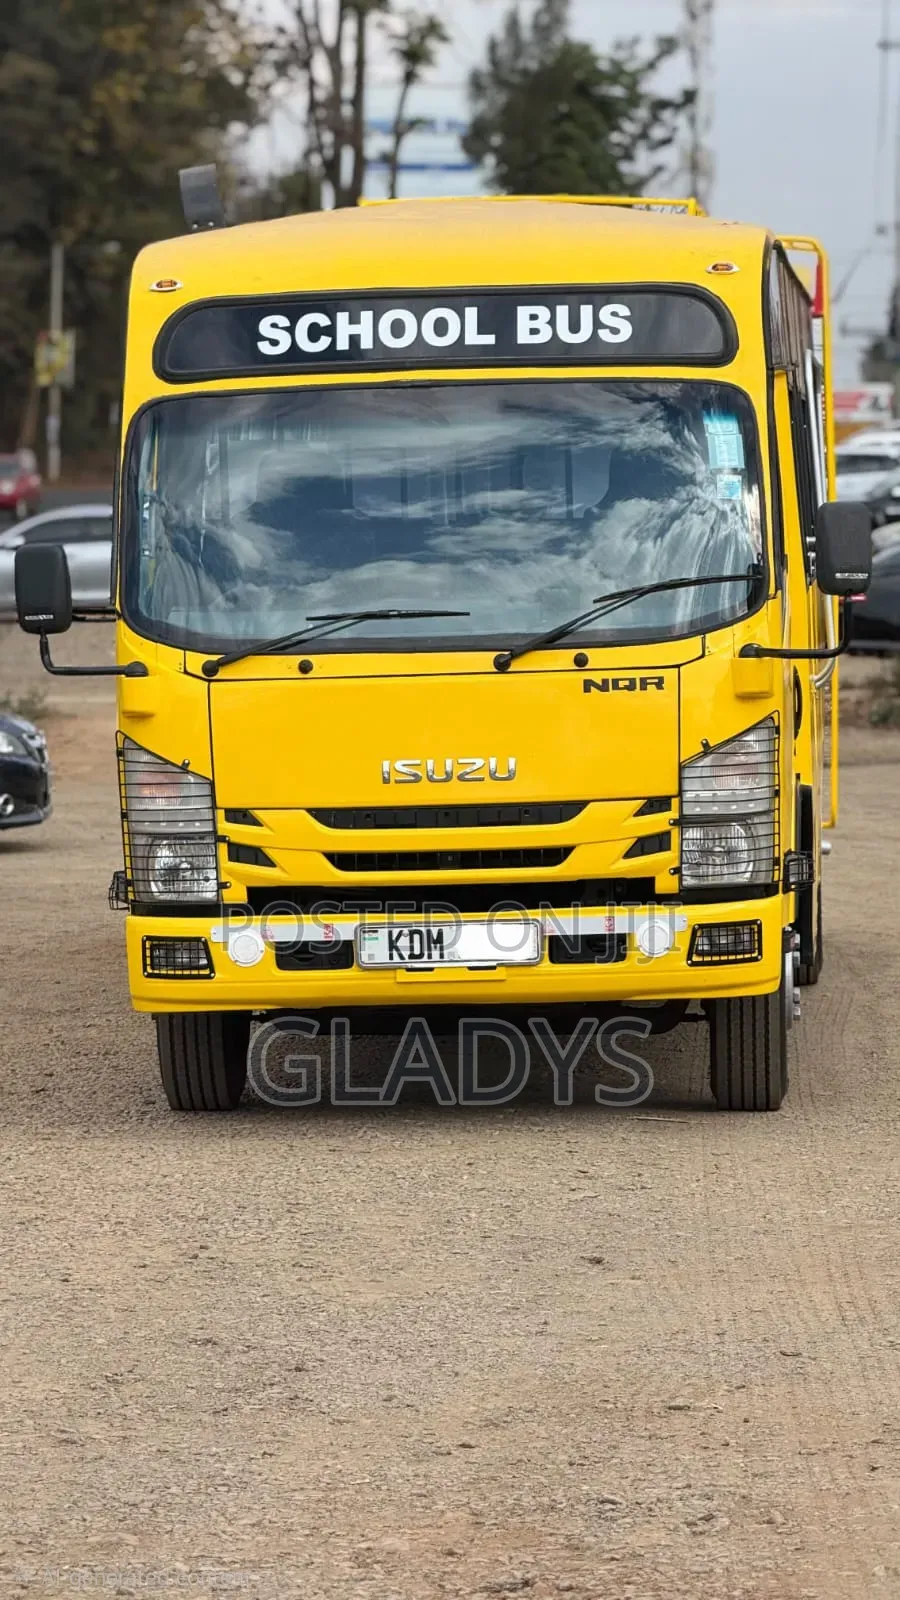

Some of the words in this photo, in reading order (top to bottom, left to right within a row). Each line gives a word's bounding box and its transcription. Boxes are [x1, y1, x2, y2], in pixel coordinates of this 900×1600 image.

[256, 306, 496, 355] SCHOOL
[516, 304, 633, 344] BUS
[583, 676, 665, 693] NQR
[381, 757, 517, 784] ISUZU
[388, 928, 444, 961] KDM
